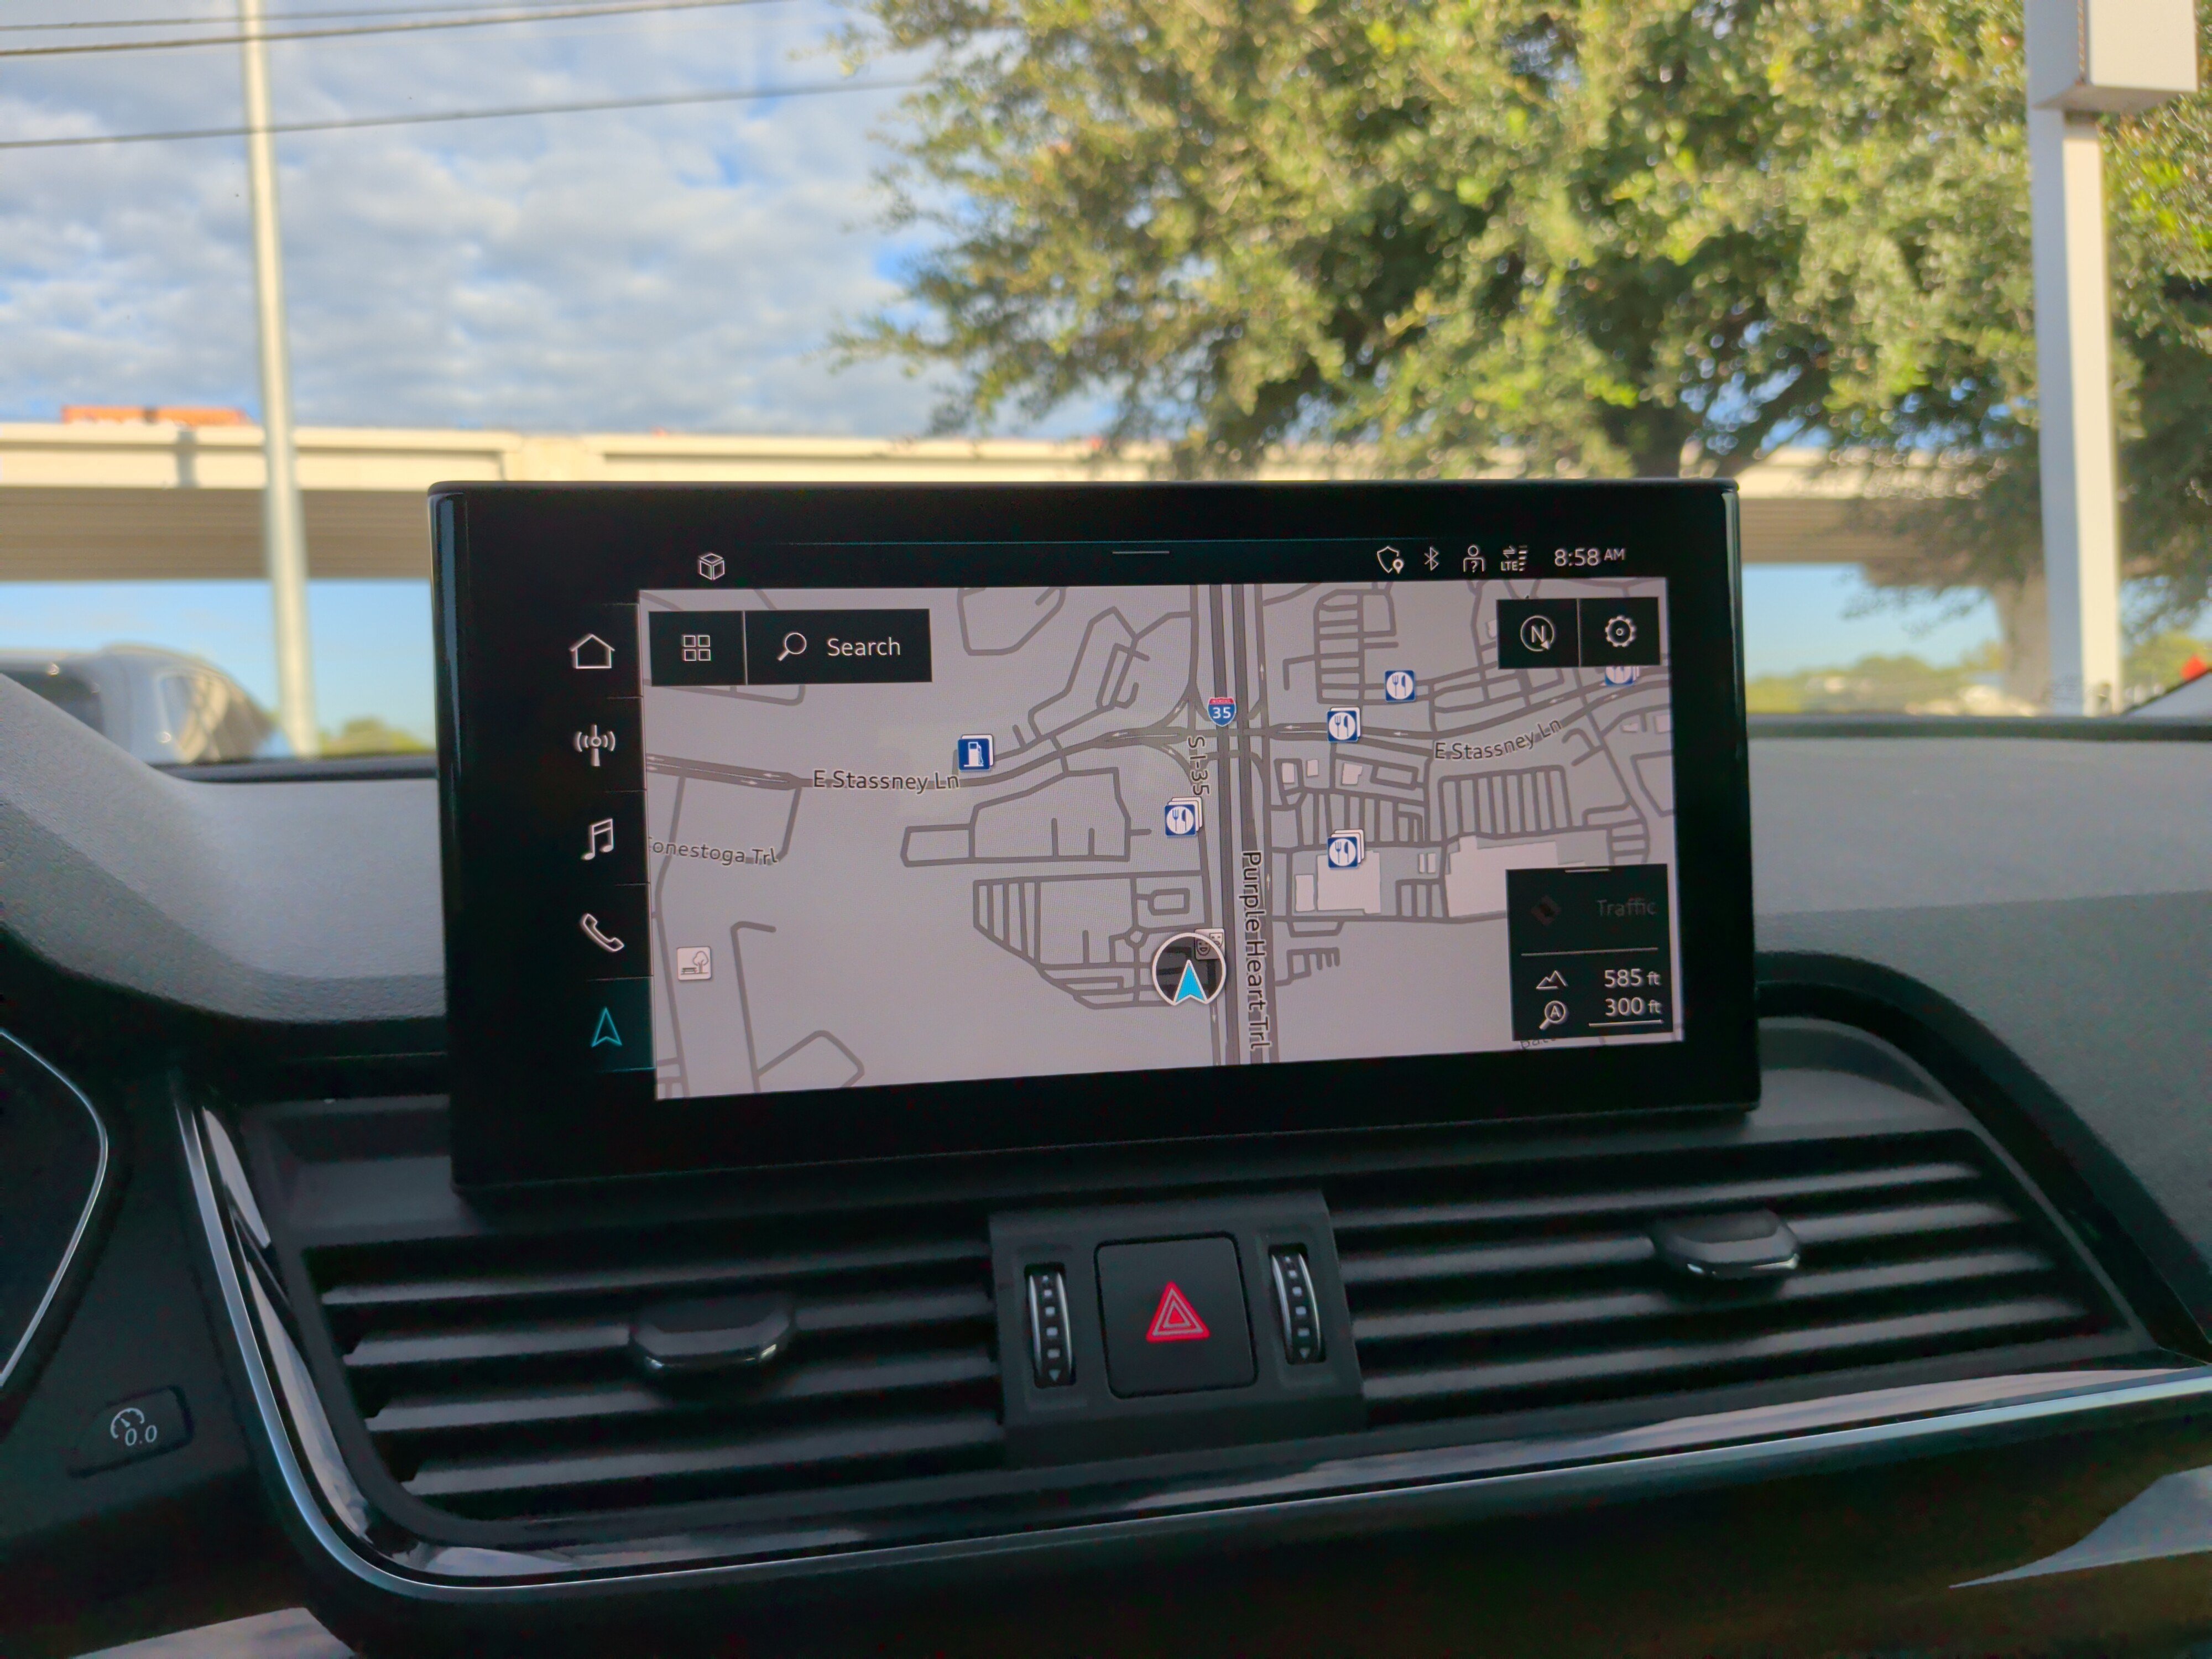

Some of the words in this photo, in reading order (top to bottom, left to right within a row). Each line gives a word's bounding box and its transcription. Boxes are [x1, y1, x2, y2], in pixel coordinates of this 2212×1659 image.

[1501, 561, 1518, 571] LTE
[1554, 547, 1600, 566] 8:58
[1604, 548, 1625, 561] AM
[1531, 625, 1545, 643] N
[827, 637, 901, 656] Search
[1213, 707, 1231, 718] 35
[1188, 736, 1204, 748] S
[1435, 742, 1446, 759] E
[1452, 732, 1534, 760] Stassney
[1537, 719, 1562, 738] Ln
[813, 770, 826, 787] E
[833, 770, 928, 795] Stassney
[935, 772, 959, 789] Ln
[1190, 755, 1209, 796] I-35
[649, 837, 745, 866] onestoga
[753, 842, 778, 864] Trl
[1239, 852, 1265, 931] Purple
[1597, 898, 1657, 916] Traffic
[1247, 941, 1266, 1011] Heart
[1605, 968, 1642, 988] 585
[1647, 972, 1661, 985] ft
[1605, 997, 1644, 1016] 300
[1648, 999, 1662, 1014] ft
[1250, 1016, 1271, 1050] Trl
[125, 1425, 157, 1446] 0.0
